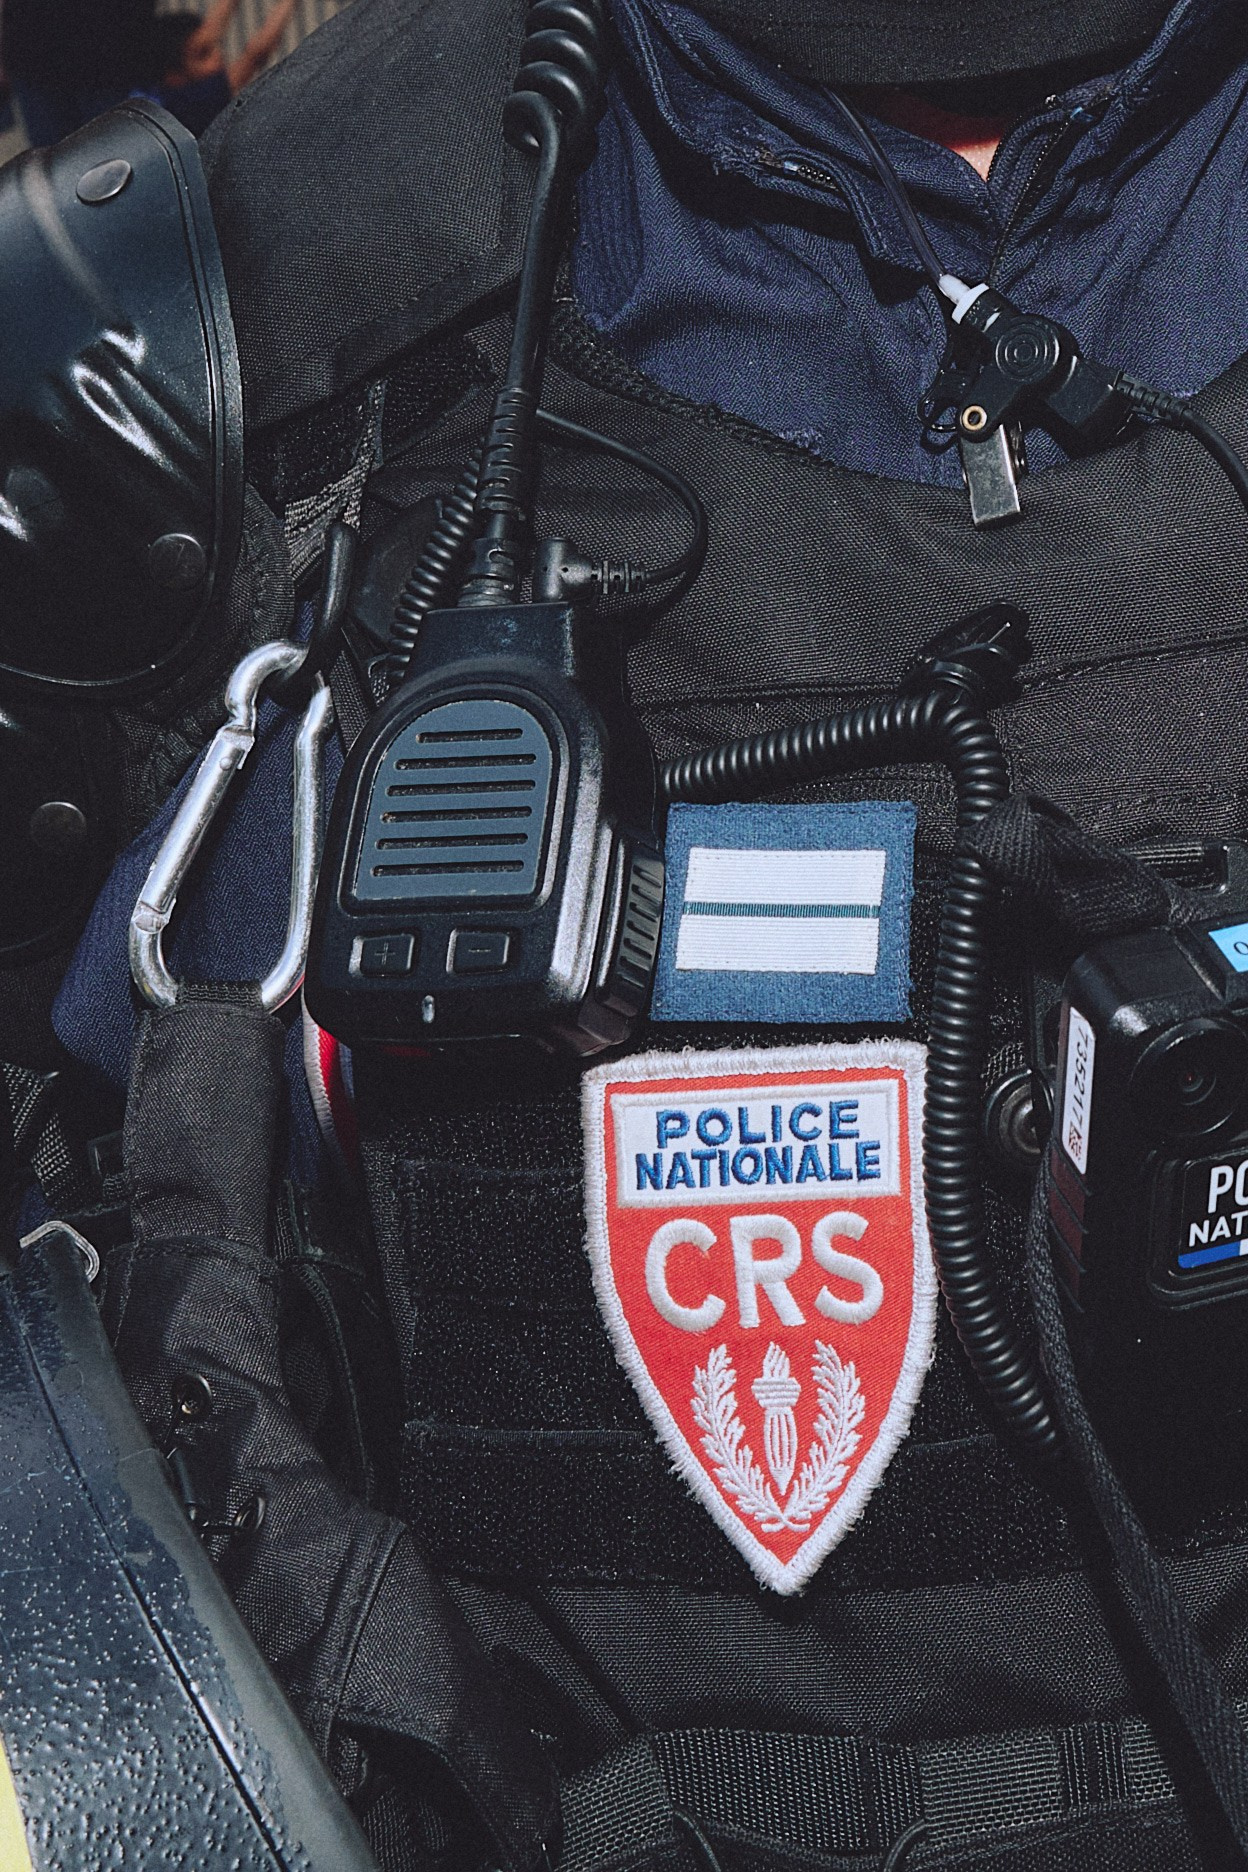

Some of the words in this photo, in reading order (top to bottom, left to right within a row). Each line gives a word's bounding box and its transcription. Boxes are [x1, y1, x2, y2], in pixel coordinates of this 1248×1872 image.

[1071, 1026, 1089, 1126] 735217
[655, 1099, 861, 1149] POLICE
[635, 1140, 882, 1192] NATIONALE
[644, 1210, 885, 1332] CRS
